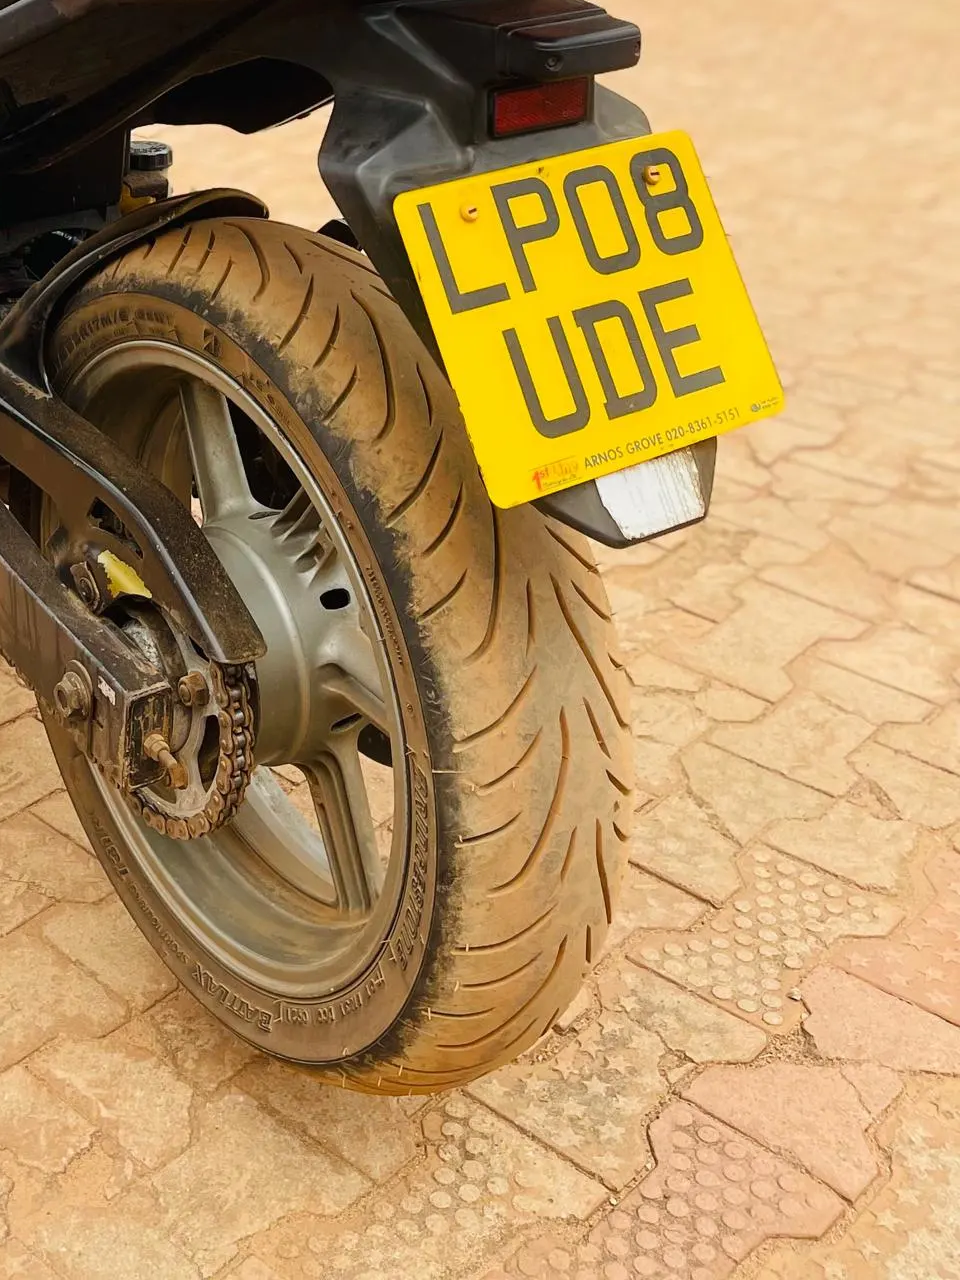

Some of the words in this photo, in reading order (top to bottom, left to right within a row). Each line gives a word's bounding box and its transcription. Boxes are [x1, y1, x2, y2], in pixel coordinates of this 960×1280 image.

[416, 147, 704, 315] LP08
[501, 278, 726, 439] UDE
[584, 446, 623, 469] ARNOS
[625, 433, 663, 455] GROVE
[665, 407, 740, 441] 020-8361-5151
[191, 962, 273, 1033] BATTLAX
